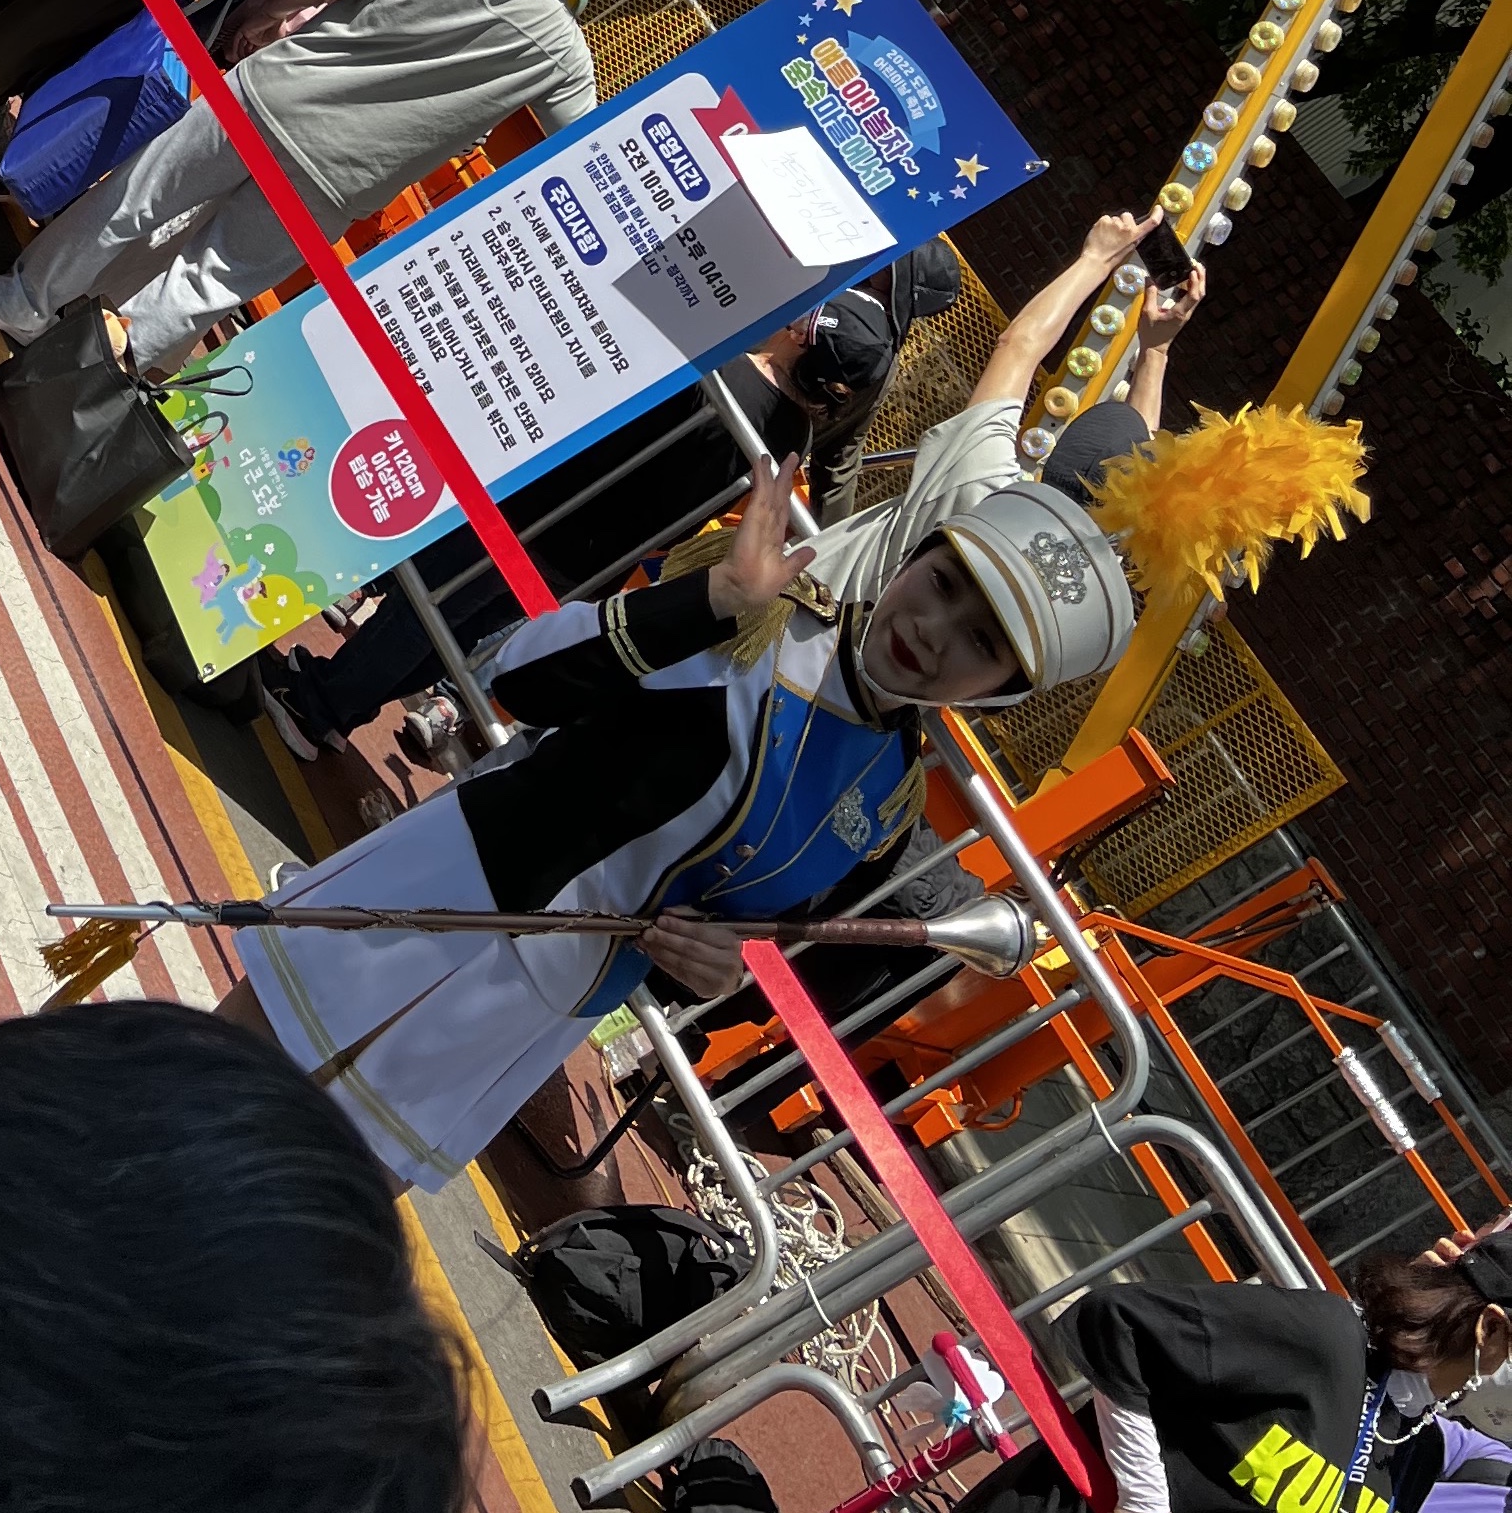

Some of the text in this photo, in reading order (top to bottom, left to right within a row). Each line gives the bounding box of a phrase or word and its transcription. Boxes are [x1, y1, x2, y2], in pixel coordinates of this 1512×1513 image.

[810, 37, 879, 119] 얘들아!
[872, 52, 925, 120] 어린이날 축제
[885, 48, 938, 110] 2022 도봉구
[647, 120, 703, 190] 운영시간
[781, 56, 896, 196] 숲속마을에서!
[549, 183, 600, 254] 주의사항
[582, 159, 661, 275] 10분간 점검을 진행합니다
[595, 152, 621, 185] 안전을
[615, 183, 636, 208] 위해
[629, 205, 650, 230] 매시
[642, 227, 665, 254] 50분
[665, 262, 700, 308] 정각까지
[618, 137, 650, 172] 오전
[639, 169, 675, 212] 10:00
[674, 226, 707, 261] 오후
[698, 260, 737, 308] 04:00
[481, 228, 524, 291] 따라주세요
[487, 205, 502, 222] 2.
[527, 274, 573, 338] 안내요원의
[564, 336, 597, 379] 지시를
[512, 189, 629, 374] 1. 순서에 맞춰 차례차례 들어가요
[364, 283, 379, 299] 6.
[372, 297, 392, 319] 1회
[383, 317, 418, 367] 입장인원
[397, 282, 447, 363] 내밀지 마세요
[402, 258, 516, 451] 5. 운행 중 일어나거나 몸을 밖으로
[426, 246, 544, 443] 4. 음식물과 날카로운 물건은 안돼요
[449, 229, 555, 404] 3. 자리에서 장난은 하지 않아요
[238, 447, 282, 516] 더 큰 도봉
[348, 453, 390, 523] 탑승 가능
[370, 450, 405, 501] 이상만
[382, 429, 425, 499] 키 120cm
